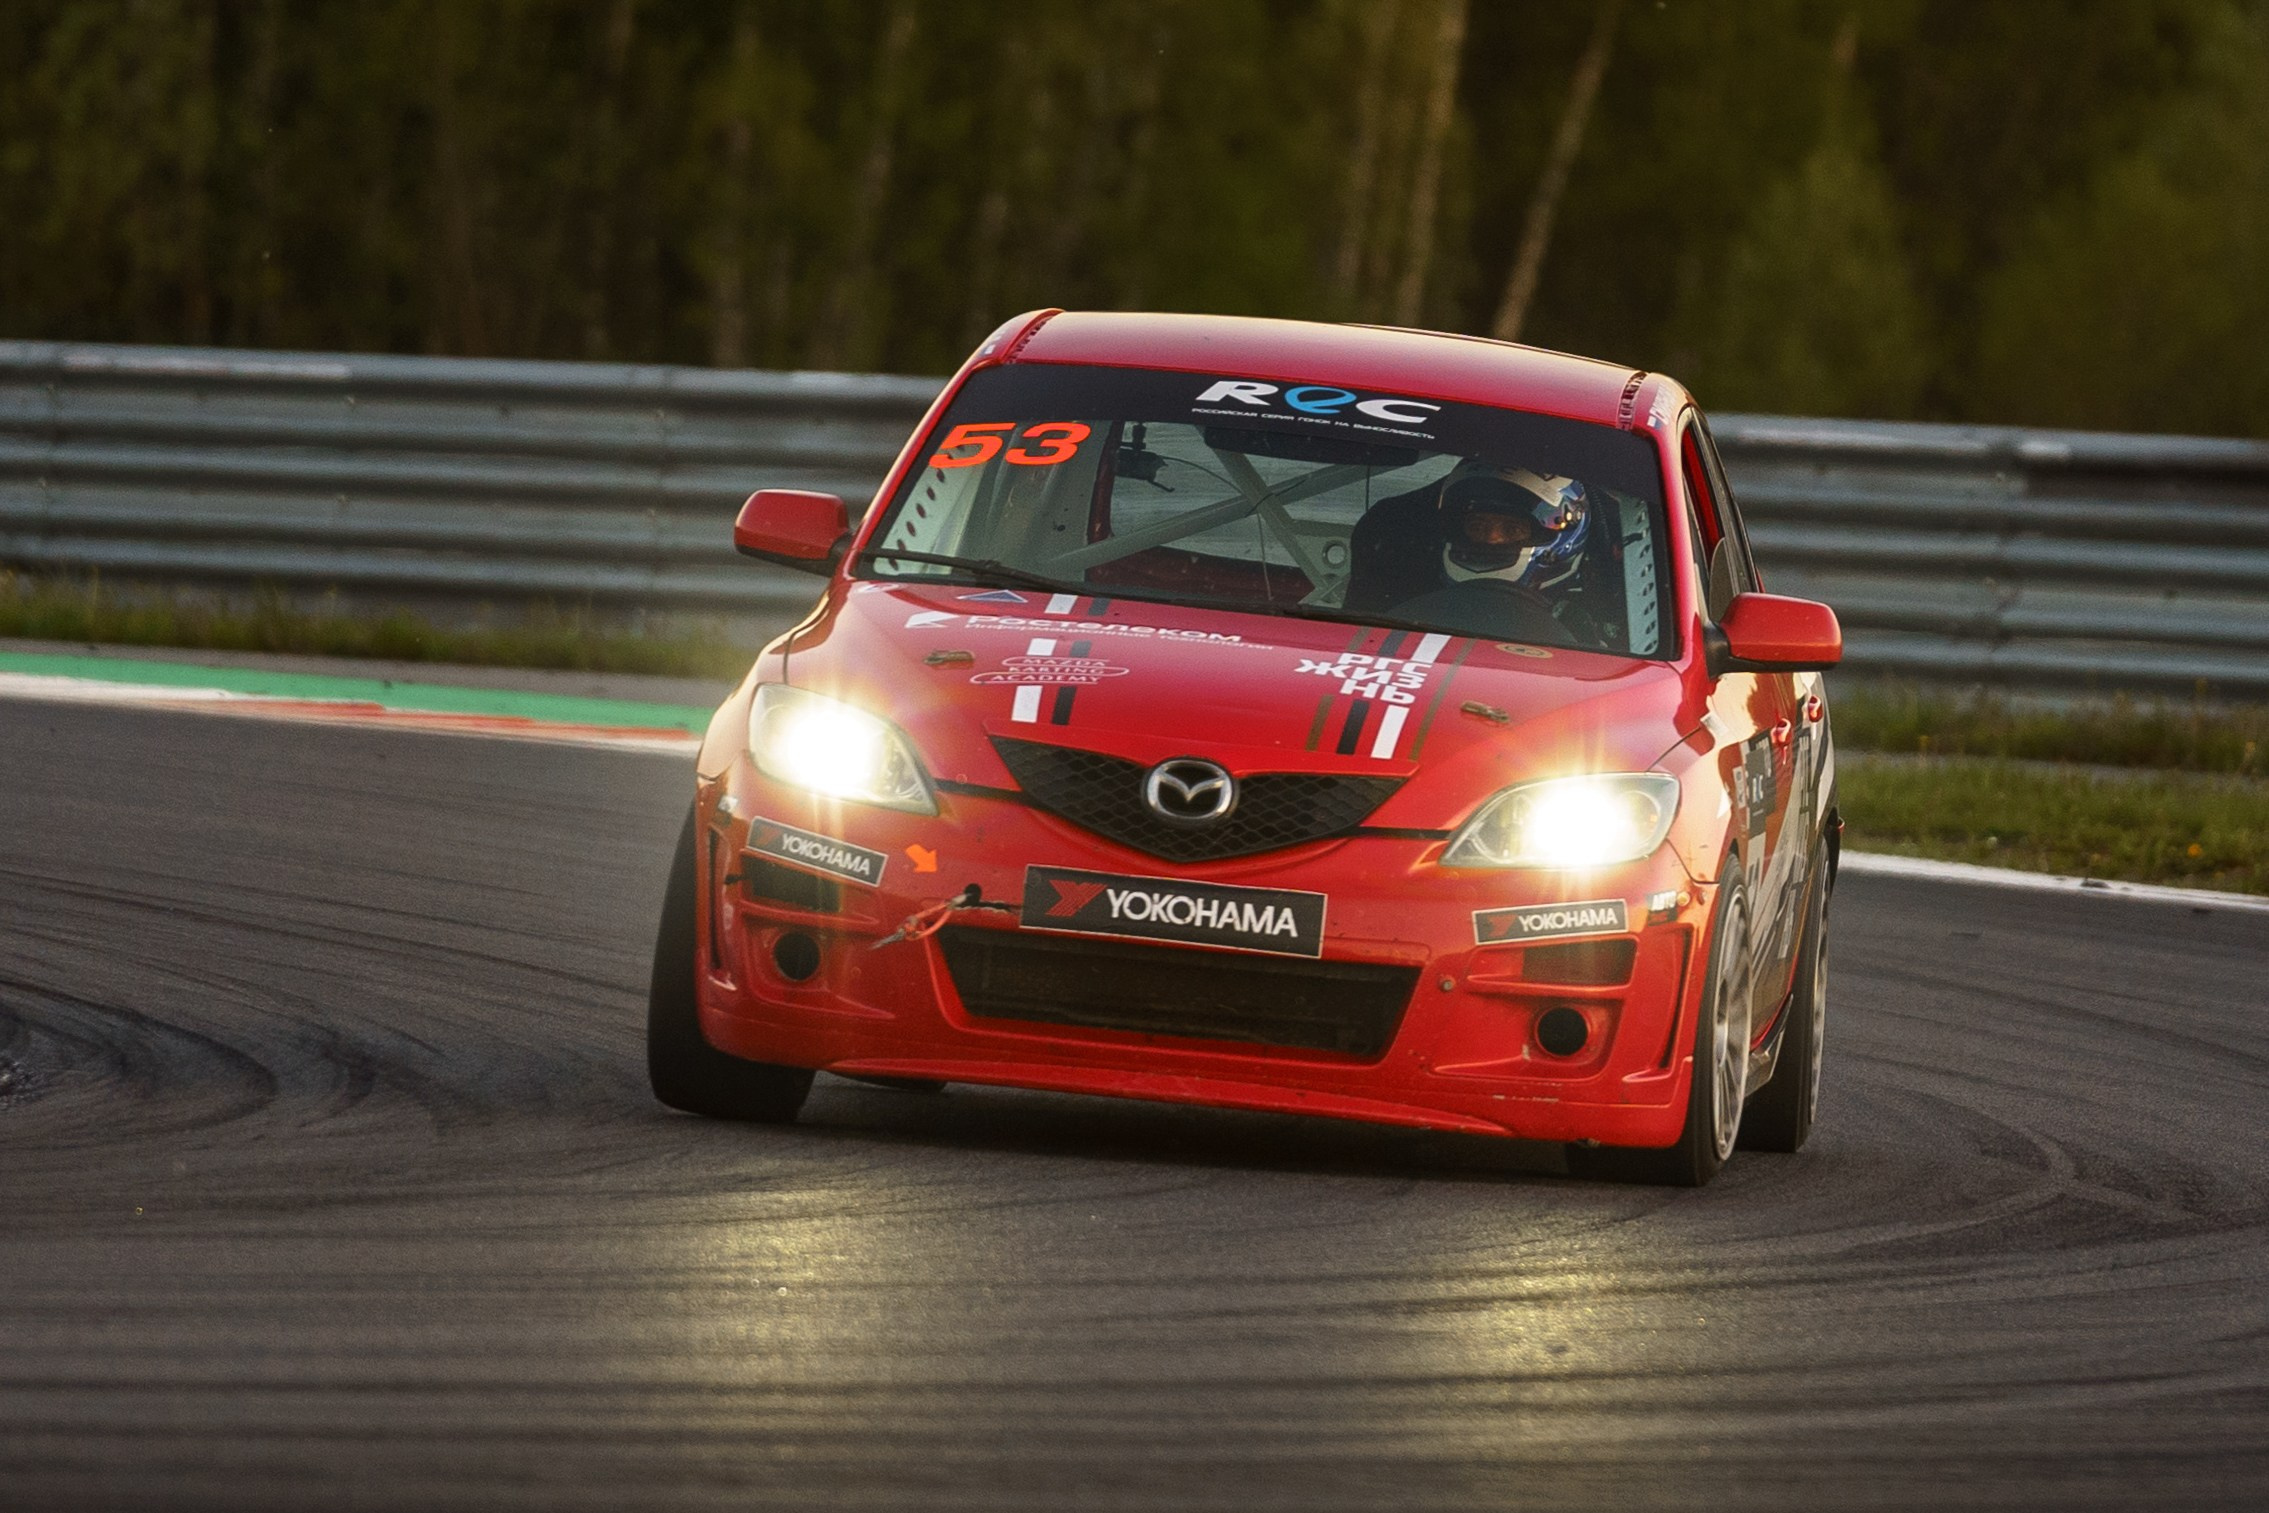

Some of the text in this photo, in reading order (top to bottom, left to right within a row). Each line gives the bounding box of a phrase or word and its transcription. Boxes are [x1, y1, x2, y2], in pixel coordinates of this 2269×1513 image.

[928, 421, 1092, 469] 53
[1008, 666, 1104, 675] KARTING
[1023, 658, 1105, 667] MAZDA
[1337, 652, 1433, 678] РГС
[991, 674, 1101, 683] ACADEMY
[1339, 678, 1416, 705] НЬ
[781, 833, 871, 875] YOKOHAMA
[1106, 888, 1298, 937] YOKOHAMA
[1518, 907, 1618, 932] YOKOHAMA
